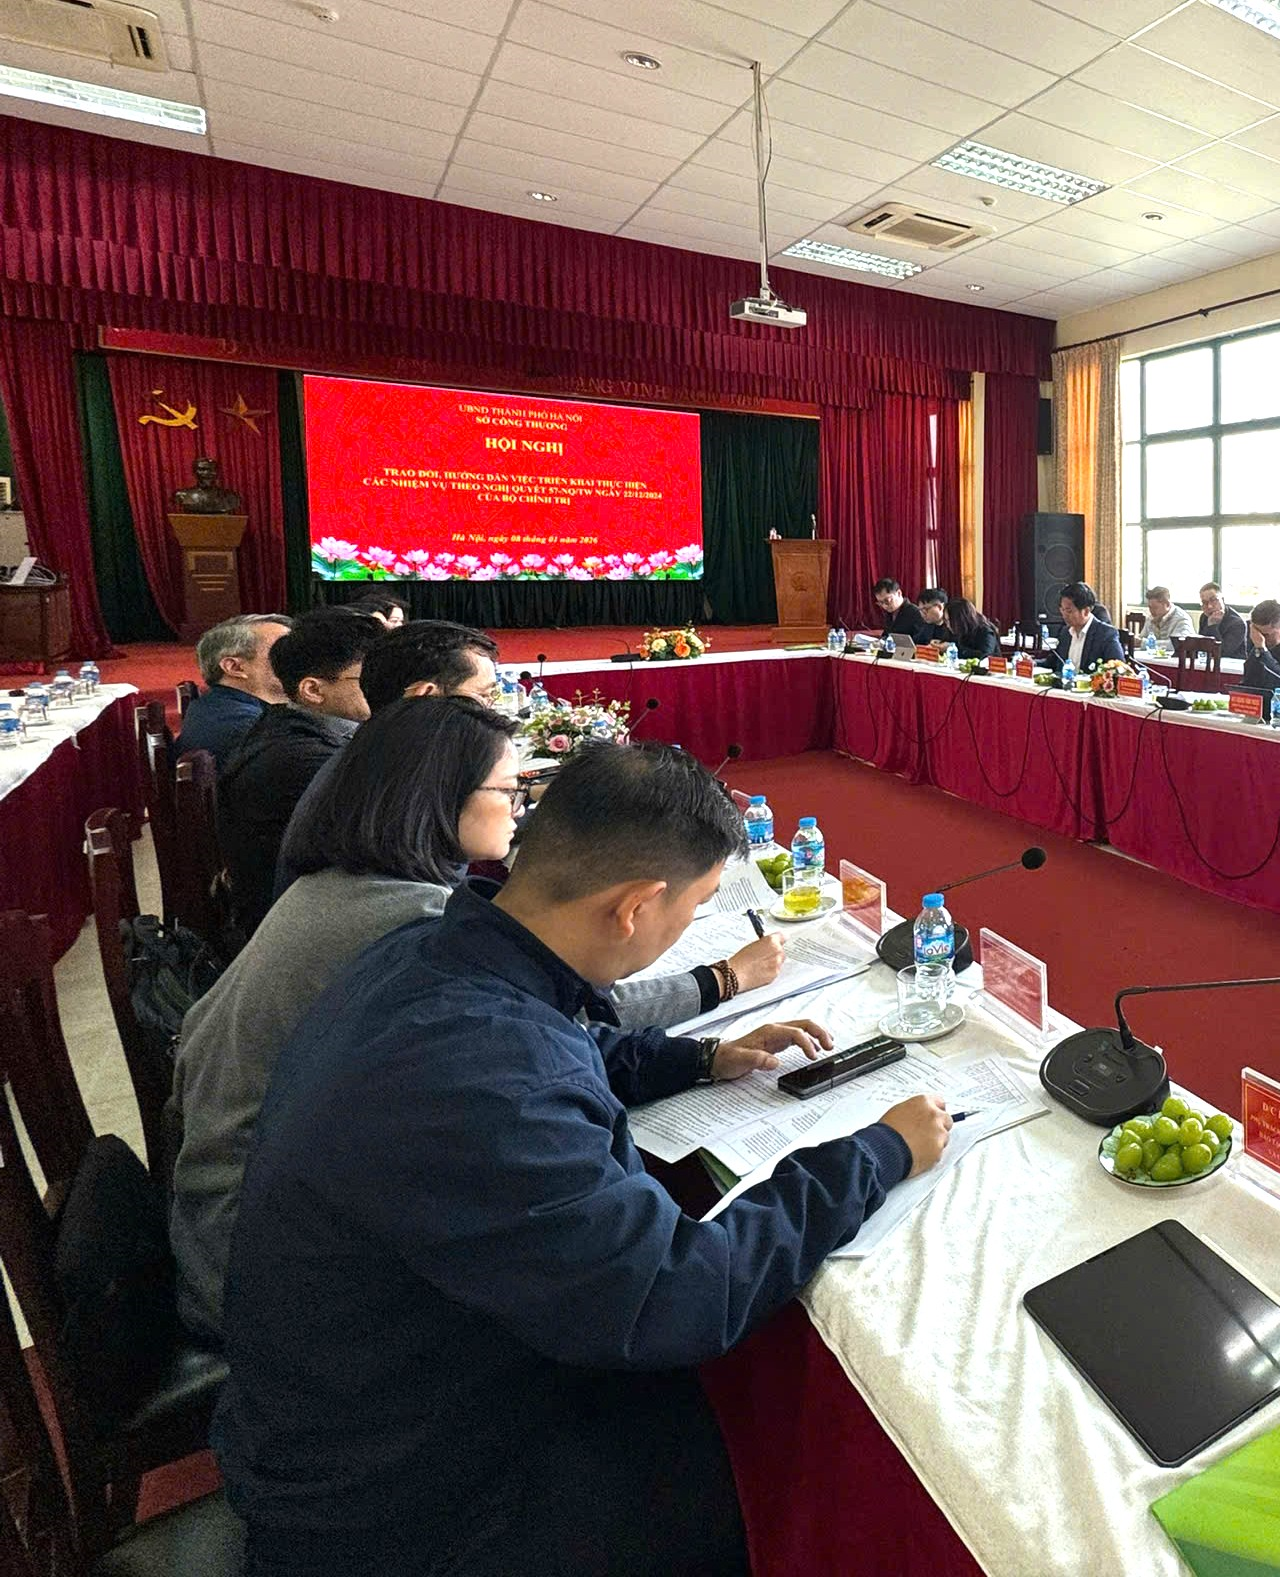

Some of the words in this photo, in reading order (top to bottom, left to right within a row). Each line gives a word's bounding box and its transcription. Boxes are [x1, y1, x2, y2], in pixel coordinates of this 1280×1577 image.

[459, 404, 489, 414] UBND
[492, 417, 523, 428] CÔNG
[485, 437, 517, 453] HỘI
[522, 440, 563, 457] NGHỊ
[363, 476, 389, 487] CÁC
[391, 479, 430, 490] NHIỆM
[431, 481, 448, 491] VỤ
[451, 482, 481, 491] THEO
[483, 483, 510, 494] NGHỊ
[383, 468, 416, 478] TRAO
[511, 474, 537, 485] VIỆC
[569, 478, 595, 487] KHAI
[502, 494, 518, 504] BỘ
[554, 496, 571, 506] TRỊ
